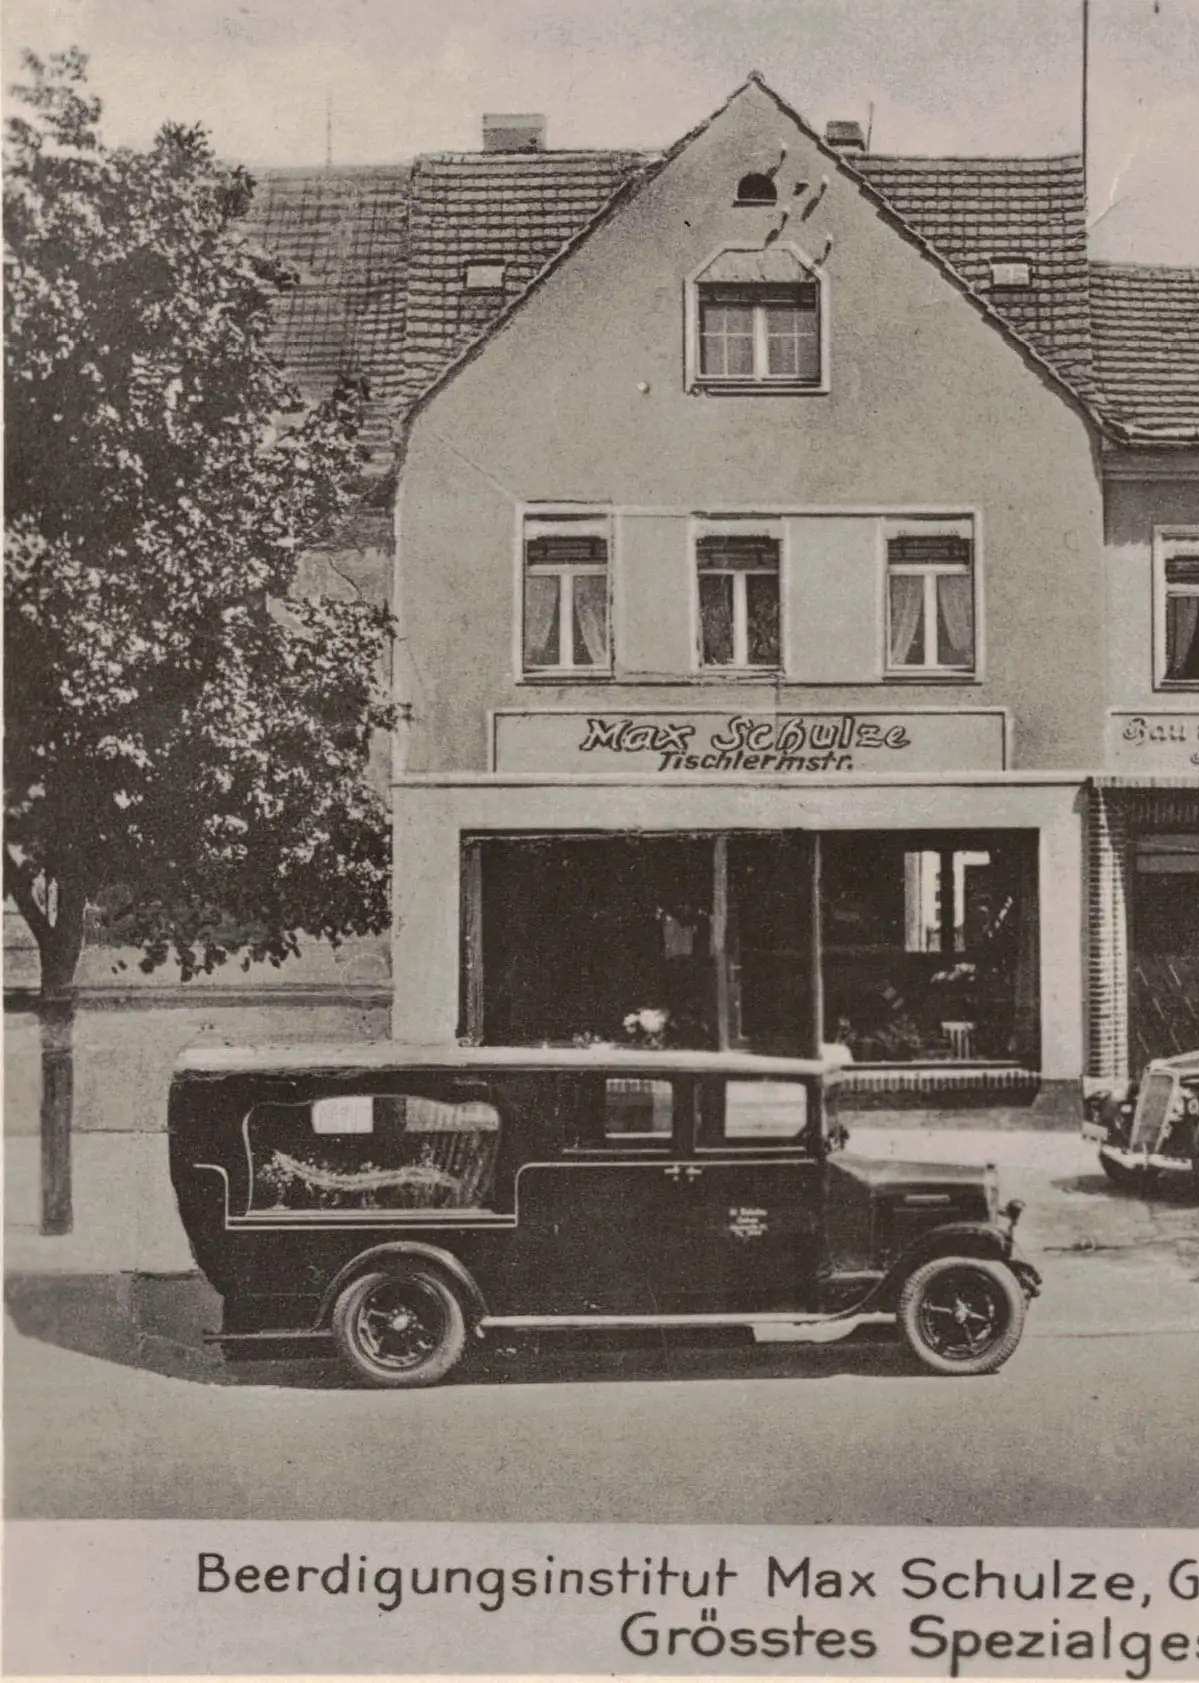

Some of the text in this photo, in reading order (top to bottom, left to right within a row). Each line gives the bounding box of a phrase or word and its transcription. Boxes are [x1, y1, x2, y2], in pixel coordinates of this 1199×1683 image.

[580, 714, 911, 753] Max Schulze
[1122, 716, 1188, 746] Bau
[657, 749, 855, 772] Tischlermstr.
